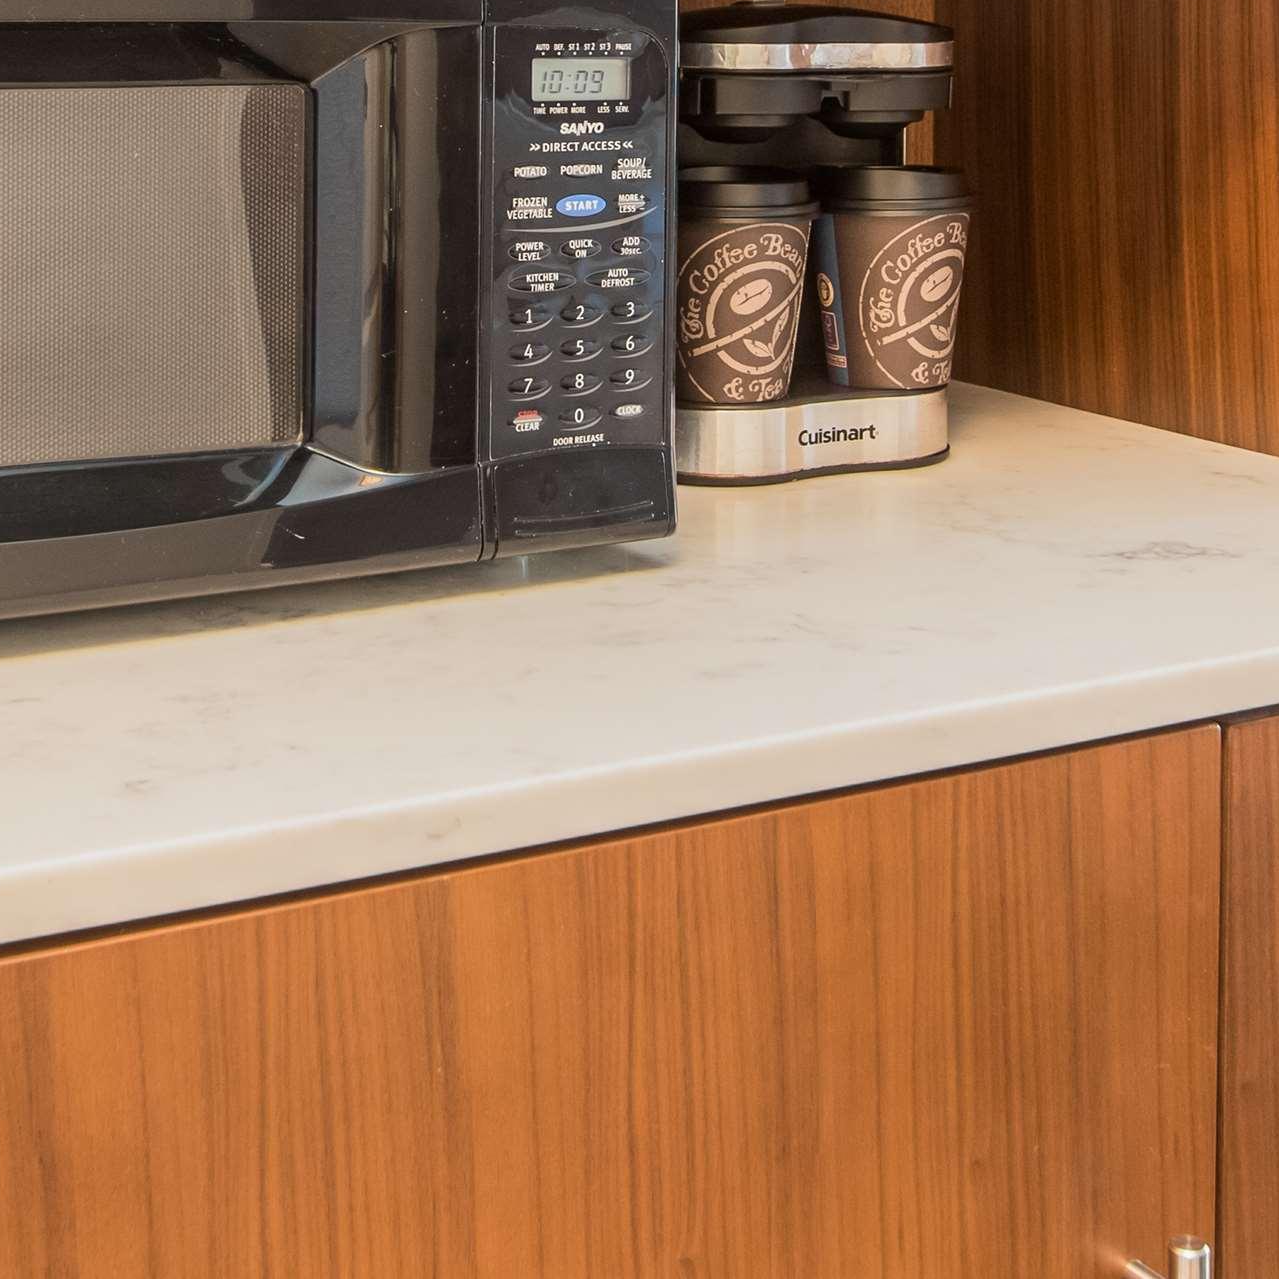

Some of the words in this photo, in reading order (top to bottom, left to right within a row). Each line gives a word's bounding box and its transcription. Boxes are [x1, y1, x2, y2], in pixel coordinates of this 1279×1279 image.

[541, 70, 605, 94] 10:09
[559, 120, 605, 136] SANYO
[542, 141, 580, 152] DIRECT
[581, 140, 621, 151] ACCESS
[617, 157, 646, 168] SOUP/
[513, 167, 548, 178] POTATO
[560, 164, 603, 175] POPCORN
[611, 169, 652, 180] BEVERAGE
[512, 197, 548, 208] FROZEN
[565, 200, 598, 211] START
[506, 208, 553, 220] VEGETABLE
[515, 242, 544, 251] POWER
[569, 239, 593, 249] QUICK
[622, 237, 641, 246] ADD
[518, 252, 542, 261] LEVEL
[575, 249, 587, 258] ON
[881, 231, 945, 284] Coffee
[607, 268, 629, 278] AUTO
[689, 243, 757, 294] Coffee
[526, 272, 559, 283] KITCHEN
[601, 277, 635, 288] DEFROST
[530, 283, 555, 292] TIMER
[576, 305, 585, 320] 2
[626, 302, 635, 317] 3
[870, 287, 894, 332] The
[525, 308, 533, 324] 1
[680, 297, 706, 343] The
[576, 340, 584, 355] 5
[625, 335, 635, 351] 6
[524, 344, 534, 359] 4
[575, 373, 585, 389] 8
[625, 369, 635, 384] 9
[524, 378, 533, 393] 7
[574, 408, 584, 423] 0
[617, 406, 641, 415] CLOCK
[515, 422, 540, 432] CLEAR
[553, 437, 573, 446] DOOR
[574, 433, 605, 444] RELEASE
[798, 424, 876, 446] Cuisinart
